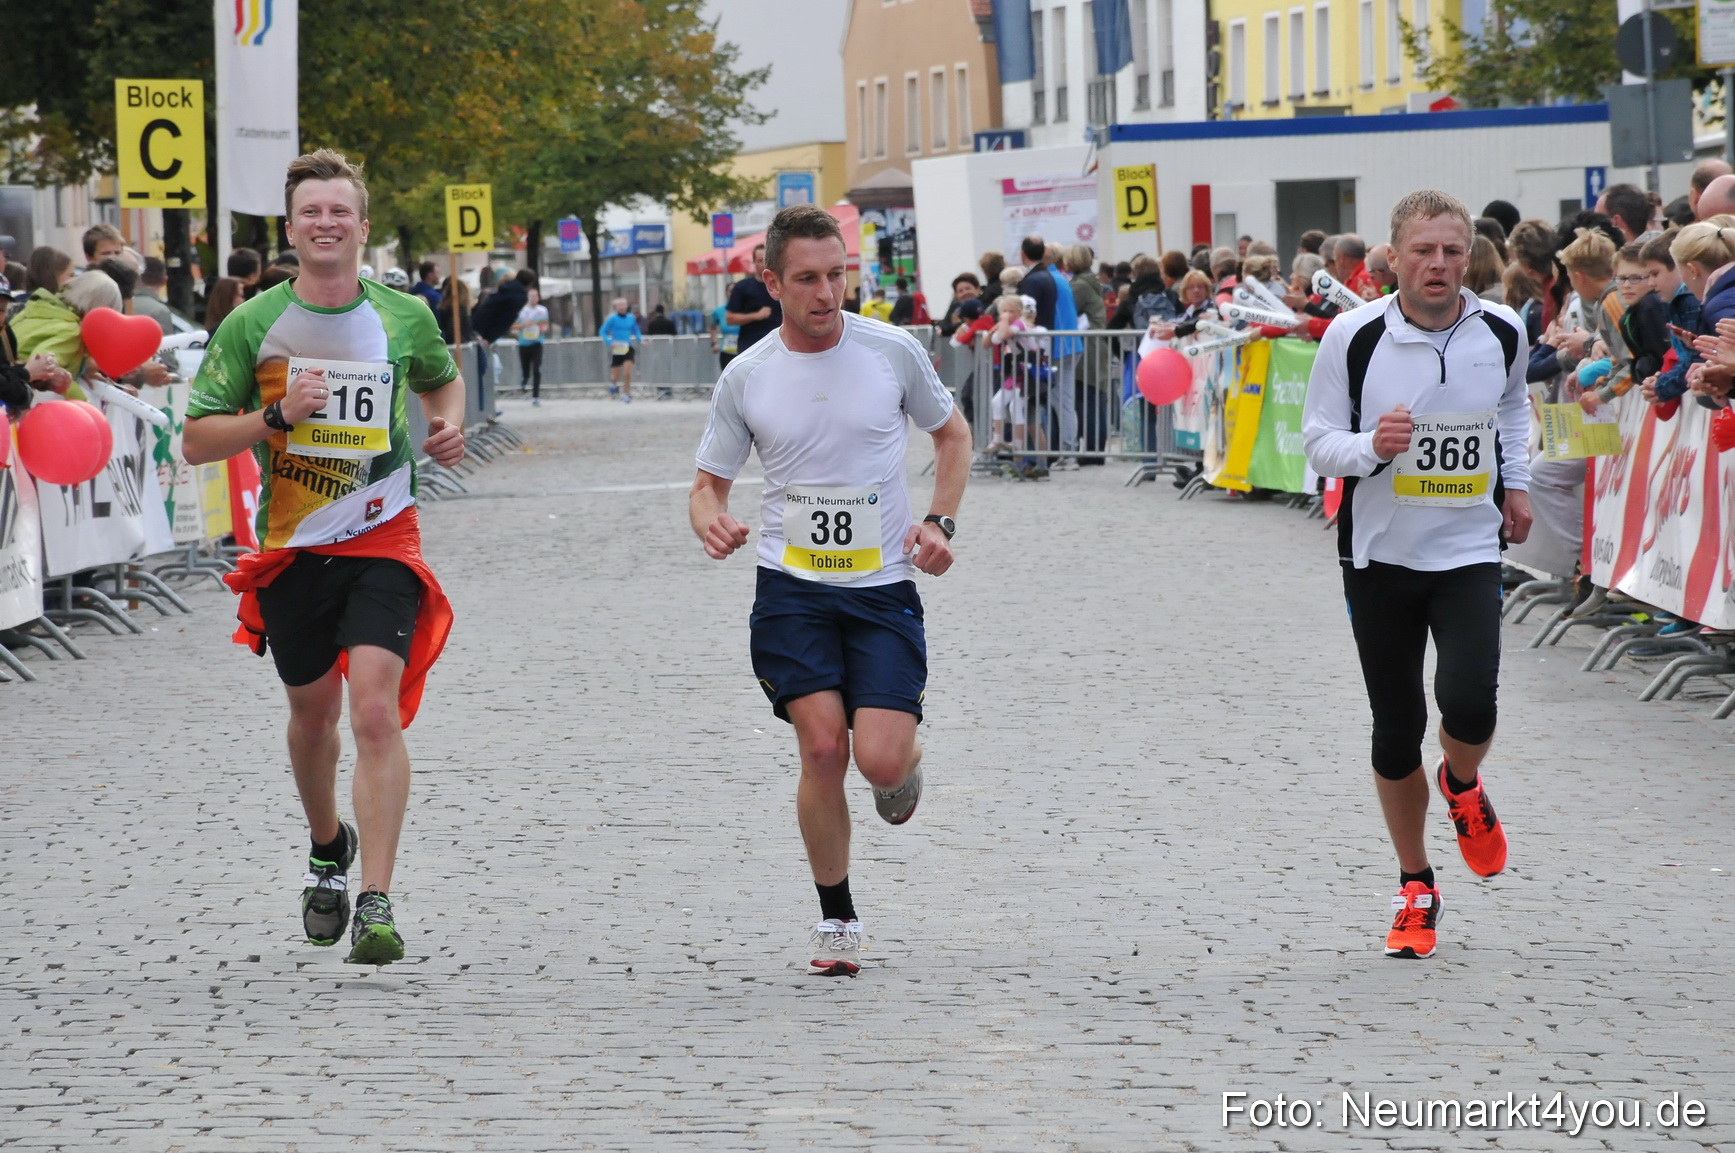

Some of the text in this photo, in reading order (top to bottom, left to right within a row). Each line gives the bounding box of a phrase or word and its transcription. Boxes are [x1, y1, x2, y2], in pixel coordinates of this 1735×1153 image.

[127, 85, 194, 108] Block
[139, 118, 183, 181] C
[1117, 167, 1153, 182] Block
[451, 188, 486, 201] Block
[1125, 185, 1148, 218] D
[459, 205, 482, 238] D
[1244, 311, 1268, 323] BMW
[328, 370, 377, 382] Neumarkt
[1411, 421, 1484, 433] RTL Neumarkt
[1543, 407, 1556, 458] URKUNDE
[311, 428, 367, 446] Günther
[1416, 435, 1480, 472] 368
[1419, 480, 1473, 494] Thomas
[786, 493, 865, 506] PARTL Neumarkt
[810, 510, 853, 546] 38
[809, 553, 853, 569] Tobias
